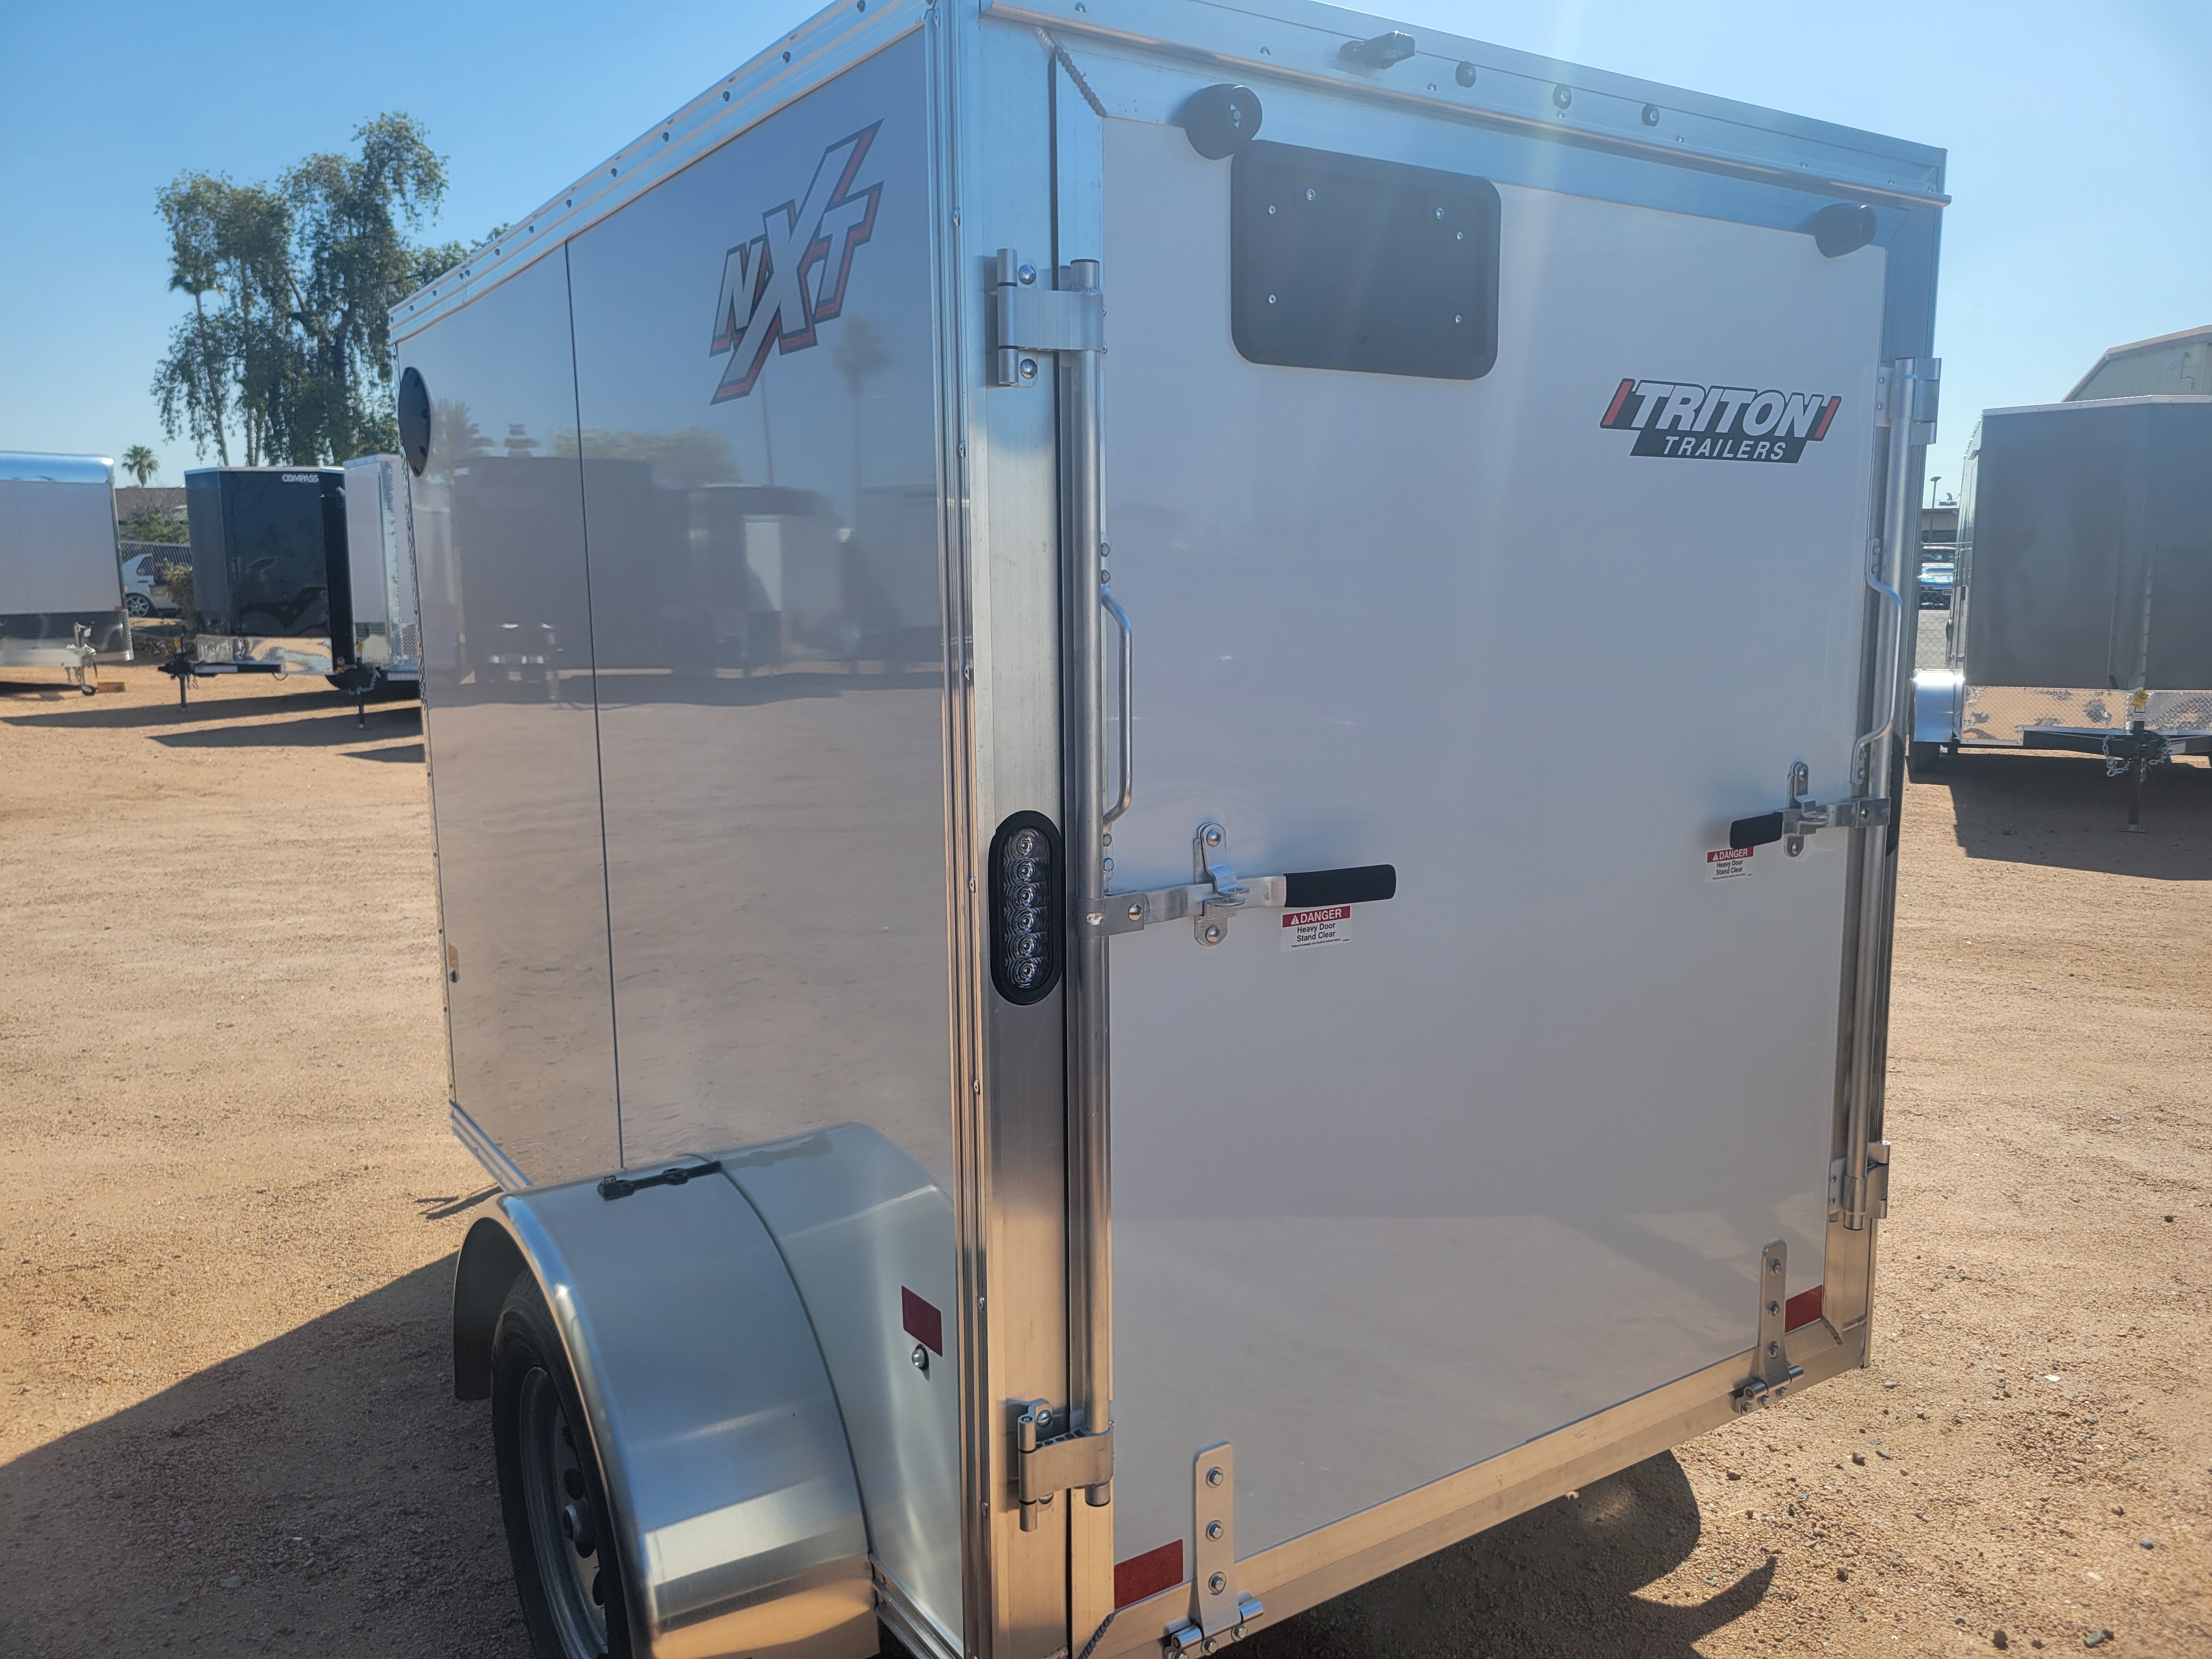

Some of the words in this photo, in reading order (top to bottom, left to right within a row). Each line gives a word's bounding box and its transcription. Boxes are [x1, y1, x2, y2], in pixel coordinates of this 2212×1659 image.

[709, 118, 885, 407] NXT
[1630, 380, 1824, 438] TRITON
[1663, 436, 1786, 460] TRAILERS
[282, 474, 319, 483] COMPASS
[1719, 848, 1748, 860] DANGER
[1300, 909, 1342, 923] DANGER
[1297, 925, 1318, 934] Heavy
[1296, 933, 1316, 942] Stand
[1318, 931, 1336, 939] Clear
